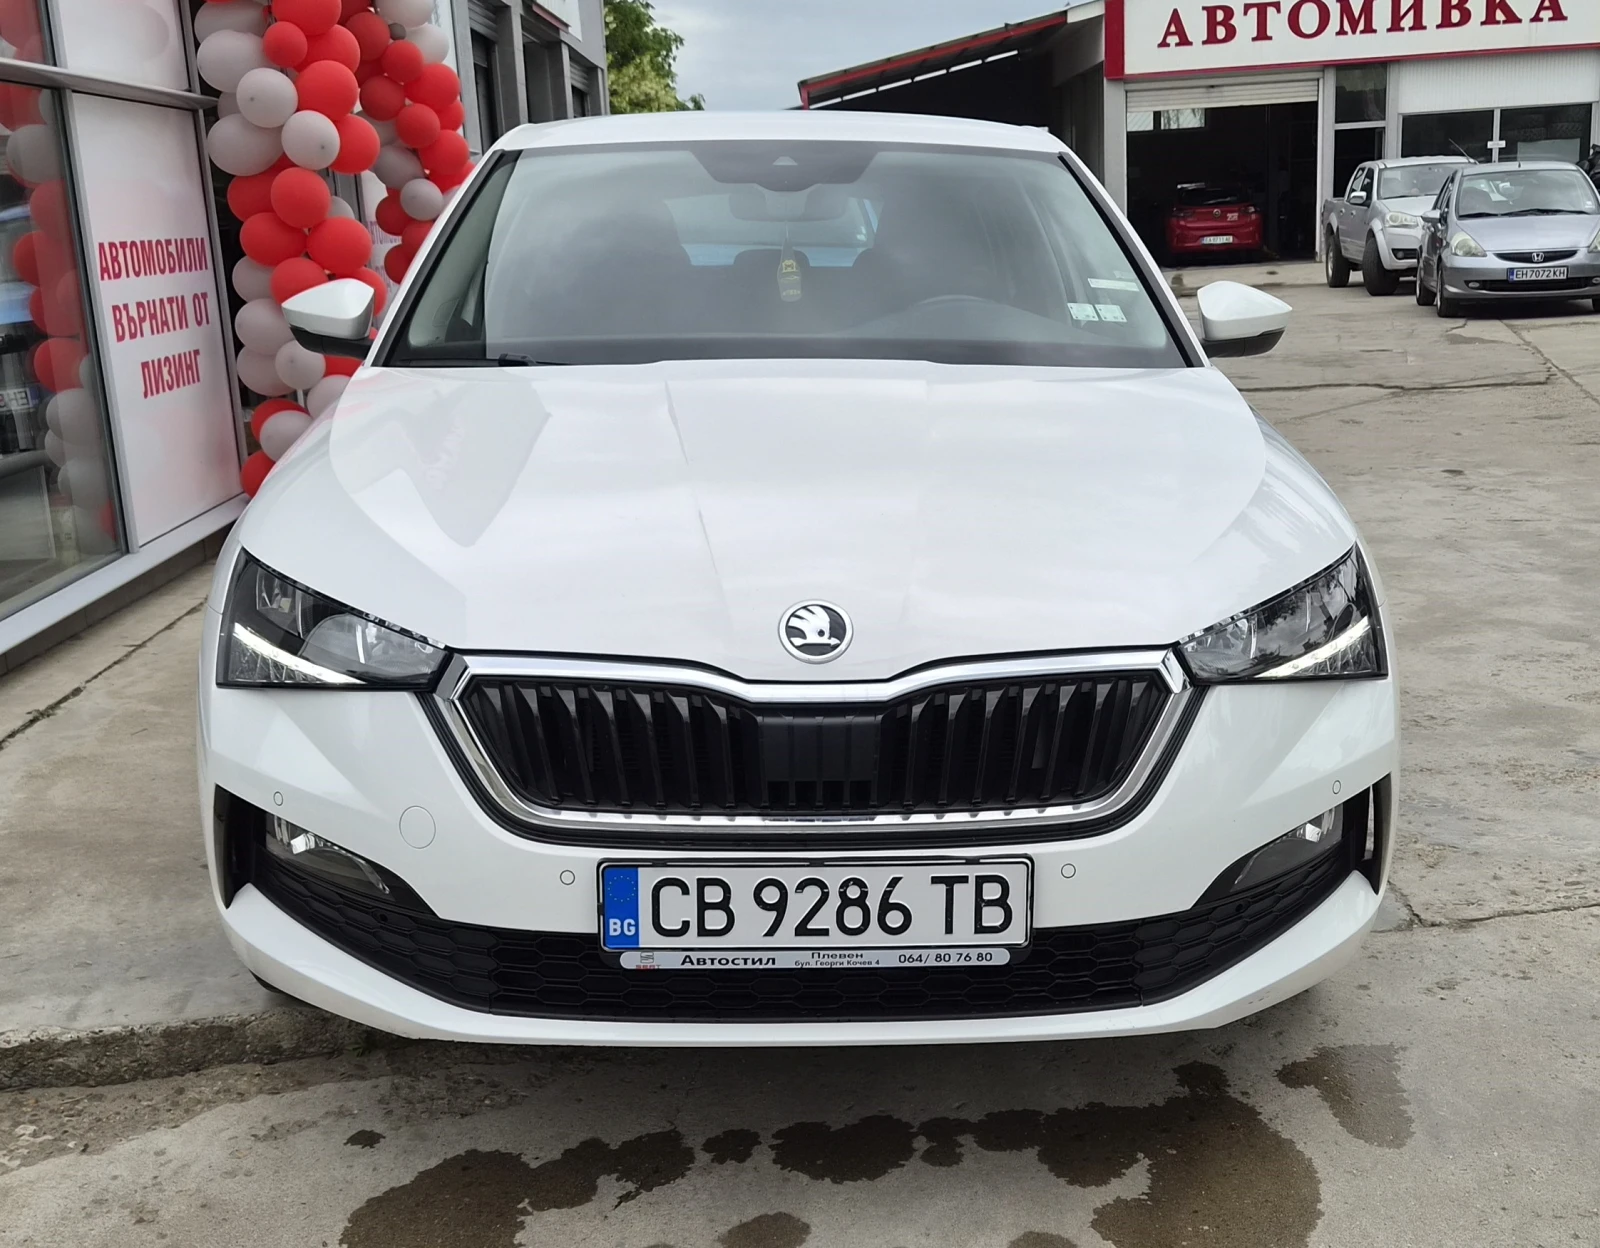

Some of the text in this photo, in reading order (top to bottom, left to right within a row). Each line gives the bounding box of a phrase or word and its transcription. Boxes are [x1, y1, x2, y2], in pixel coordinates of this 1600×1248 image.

[1157, 0, 1568, 48] АВТОМИВКА
[98, 237, 208, 281] АВТОМОБИЛИ
[111, 292, 210, 343] ВЪРНАТИ ОТ
[140, 349, 201, 399] ЛИЗИНГ
[651, 874, 1013, 938] CB 9286 TB
[609, 918, 636, 936] BG
[681, 954, 776, 966] Автостил
[811, 951, 864, 959] Плевен
[815, 959, 845, 967] Георги
[898, 952, 993, 964] 064/ 80 76 80
